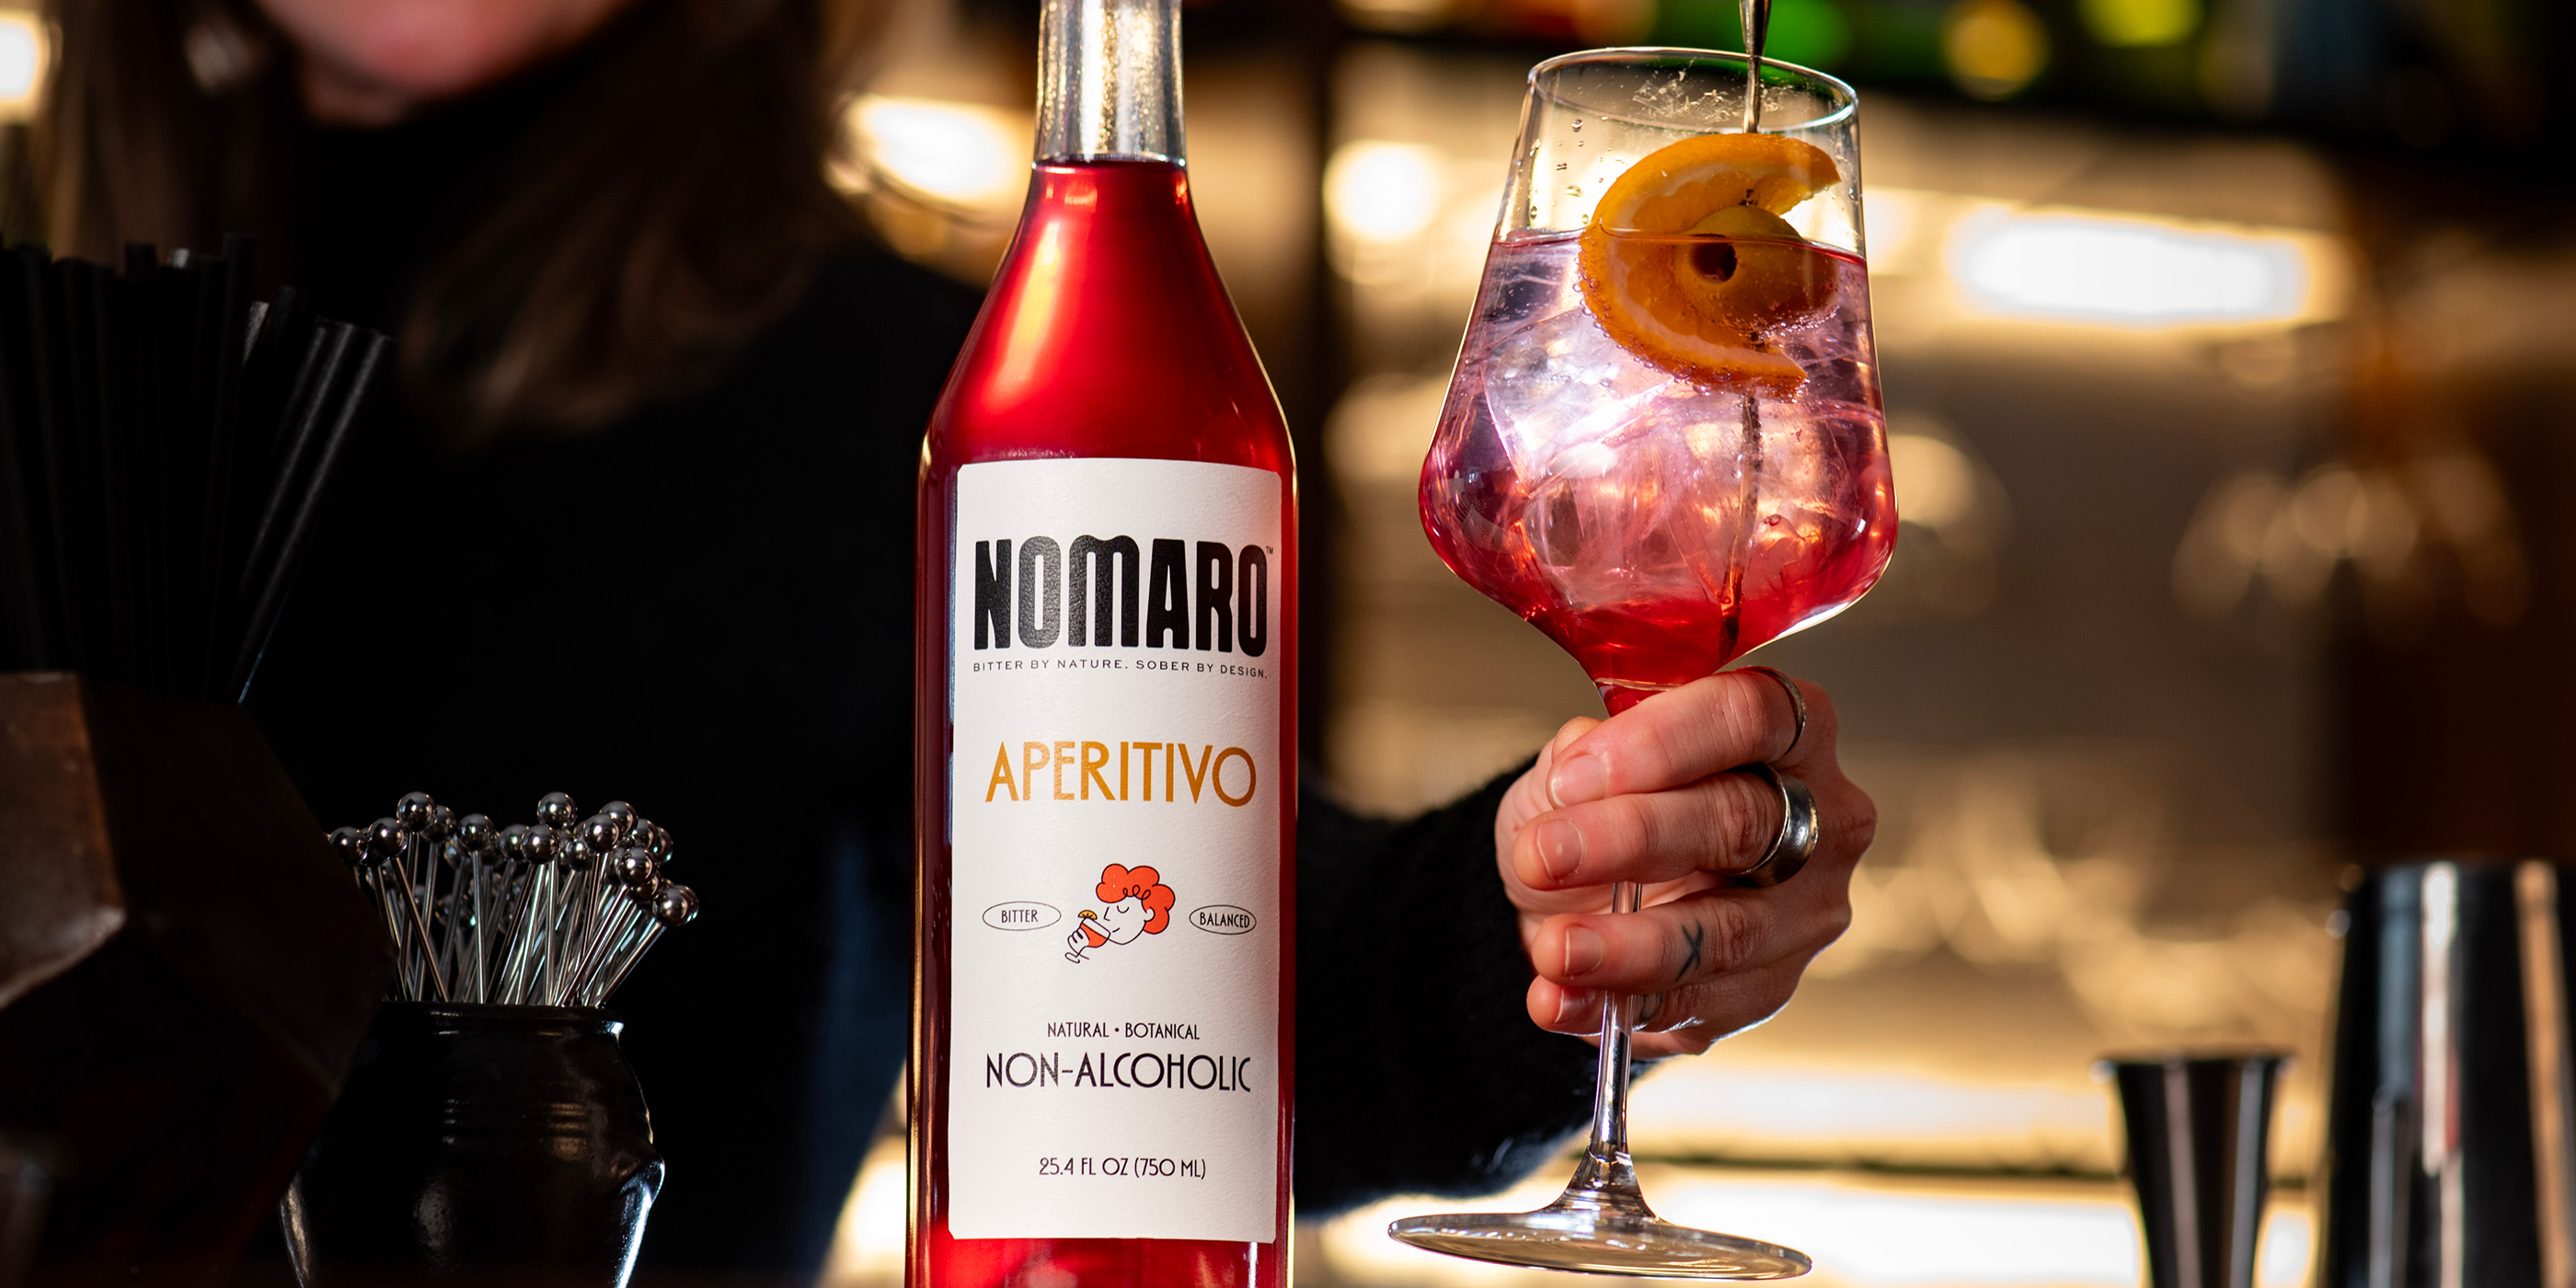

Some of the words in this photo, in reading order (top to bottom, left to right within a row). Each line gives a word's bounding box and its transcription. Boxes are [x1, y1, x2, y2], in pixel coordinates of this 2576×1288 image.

[973, 534, 1268, 658] NOMARO
[972, 660, 1023, 673] BITTER
[1030, 659, 1050, 670] BY
[1057, 659, 1129, 670] NATURE.
[1136, 660, 1190, 672] SOBER
[1197, 662, 1214, 673] BY
[1220, 663, 1268, 679] DESIGN.
[984, 740, 1258, 807] APERITIVO
[1000, 909, 1039, 924] BITTER
[1199, 911, 1251, 929] BALANCED
[1047, 1021, 1110, 1038] NATURAL
[1125, 1022, 1201, 1041] BOTANICAL
[985, 1052, 1251, 1093] NON-ALCOHOLIC
[1039, 1156, 1074, 1176] 25.4
[1081, 1156, 1097, 1176] FL
[1101, 1157, 1129, 1176] OZ
[1133, 1156, 1176, 1179] (750
[1180, 1158, 1207, 1180] ML)
